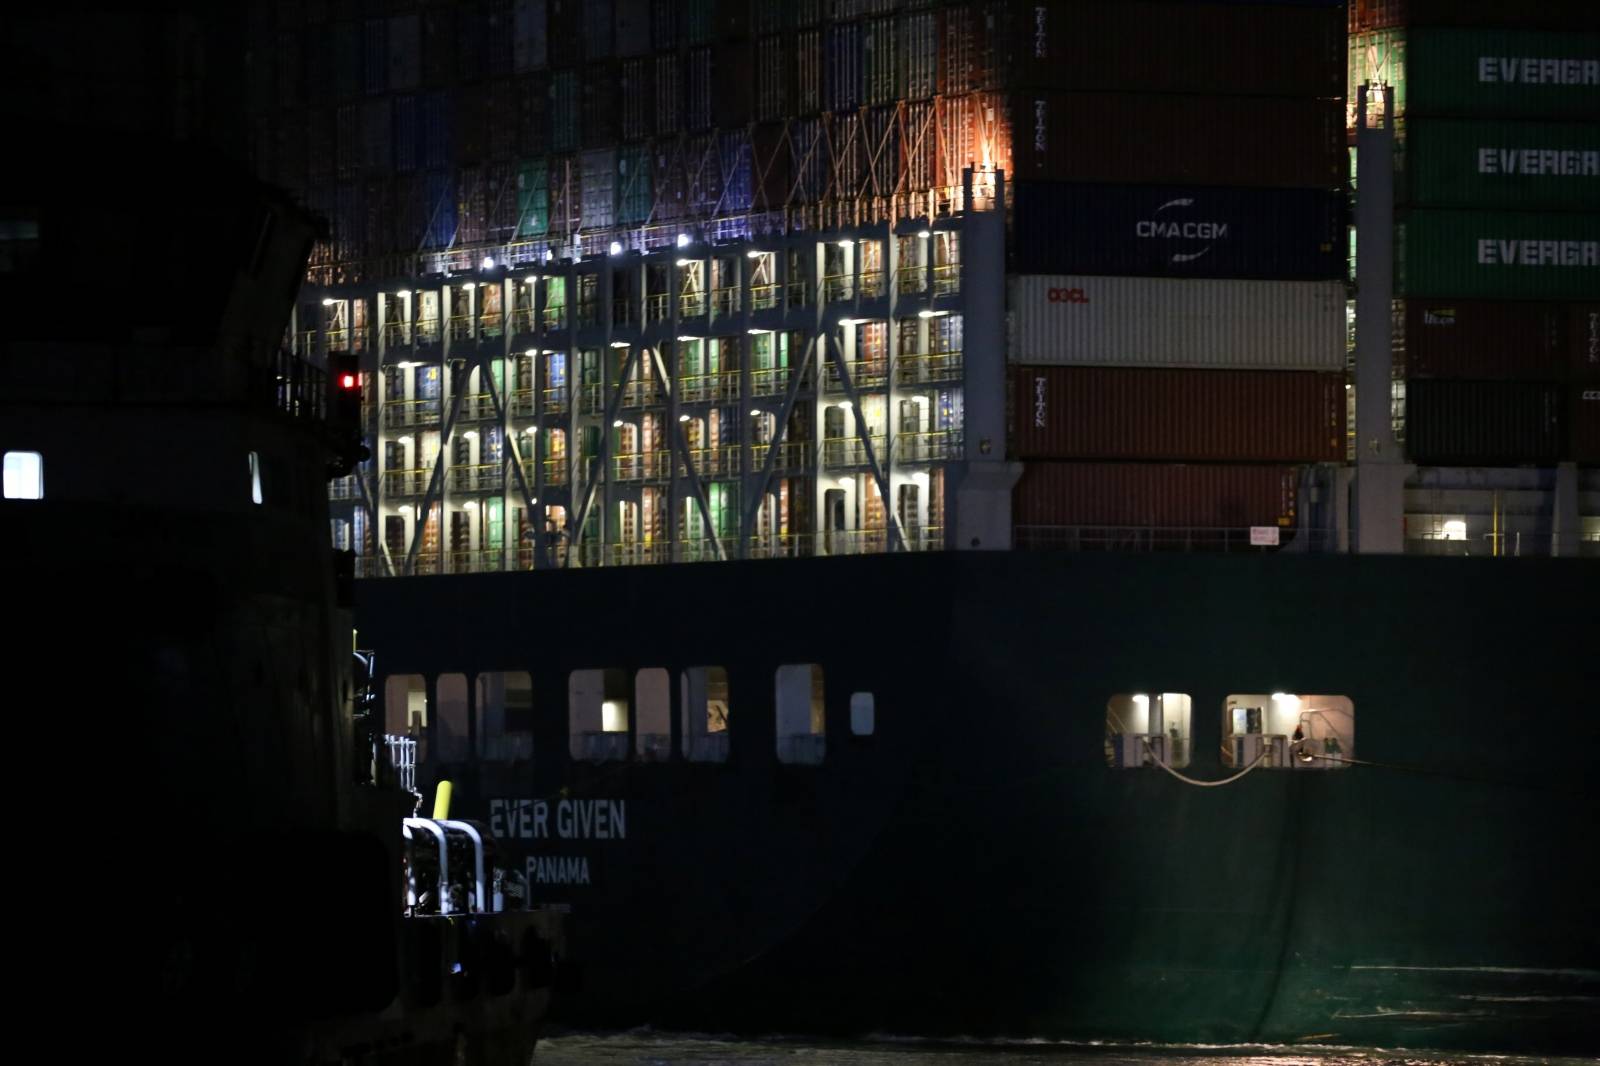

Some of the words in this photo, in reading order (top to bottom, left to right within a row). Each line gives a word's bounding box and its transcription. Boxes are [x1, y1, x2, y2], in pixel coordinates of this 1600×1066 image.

[1034, 100, 1048, 152] TRITON
[1034, 376, 1047, 428] TRITON
[489, 799, 549, 839] EVER
[556, 799, 627, 840] GIVEN
[525, 855, 591, 885] PANAMA
